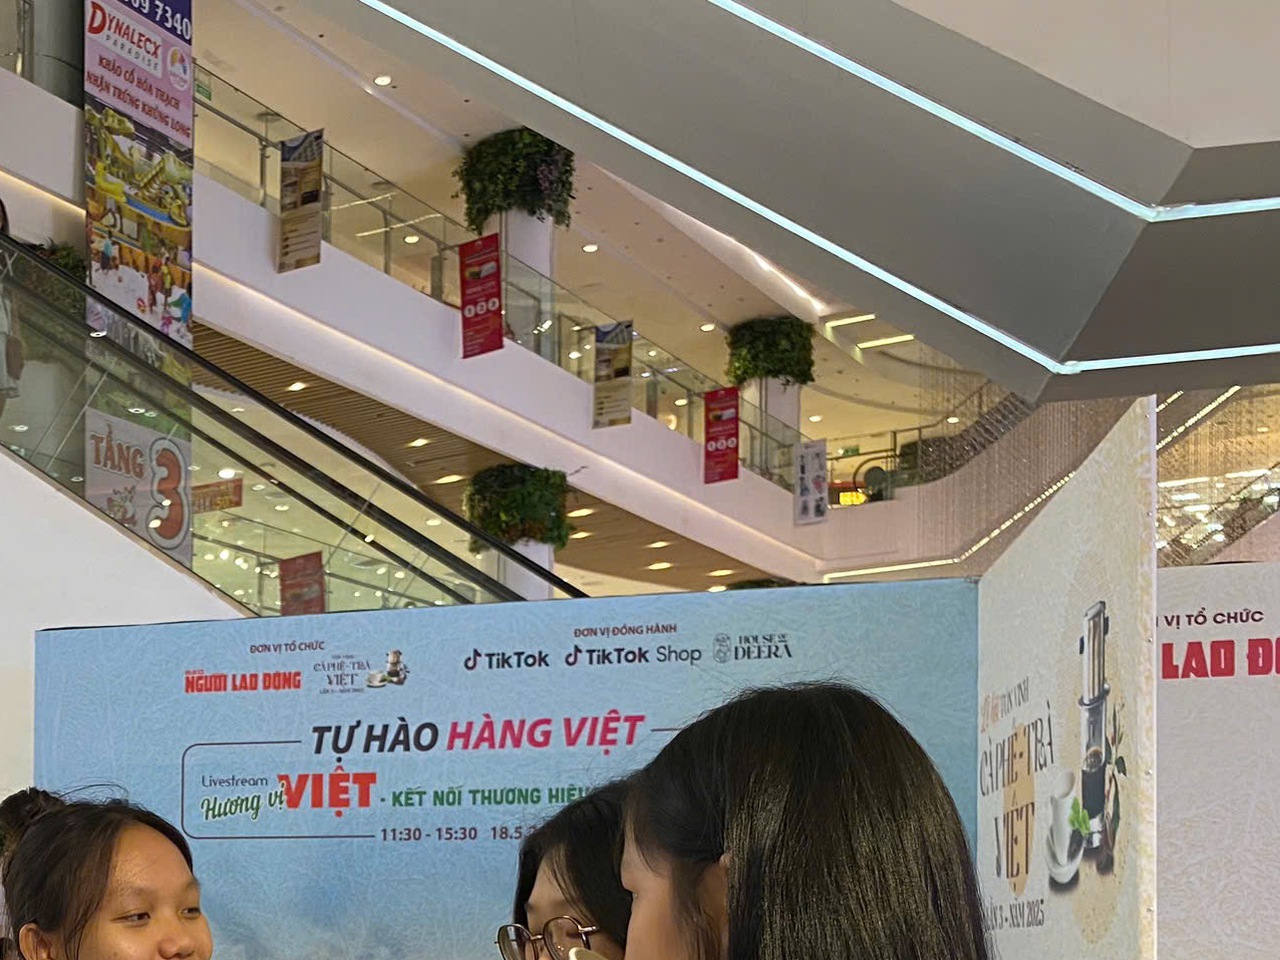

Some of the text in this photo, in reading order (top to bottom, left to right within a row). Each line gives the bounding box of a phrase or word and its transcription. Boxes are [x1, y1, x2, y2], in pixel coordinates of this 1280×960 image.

[87, 1, 161, 58] DYNALECX
[155, 1, 191, 40] 7340
[106, 34, 158, 71] PARADISE
[150, 441, 185, 545] 3
[1164, 607, 1264, 629] VỊ TỔ CHỨC
[574, 627, 598, 638] ĐƠN
[599, 627, 610, 637] VỊ
[645, 623, 677, 634] HÀNH
[250, 643, 270, 653] ĐƠN
[272, 643, 282, 655] VỊ
[587, 646, 702, 666] TikTok Shop
[734, 644, 792, 660] DEERA
[1162, 637, 1280, 679] LAO Đ
[486, 650, 549, 670] TikTok
[231, 672, 258, 691] LAO
[312, 709, 645, 763] TỰ HÀO HÀNG VIỆT
[201, 775, 268, 787] Livestream
[201, 793, 261, 821] Hương
[268, 782, 286, 810] vị
[277, 765, 376, 818] VIỆT
[392, 786, 426, 806] KẾT
[433, 785, 463, 806] NỐI
[468, 787, 540, 805] THƯƠNG
[380, 828, 422, 841] 11:30
[436, 827, 477, 840] 15:30
